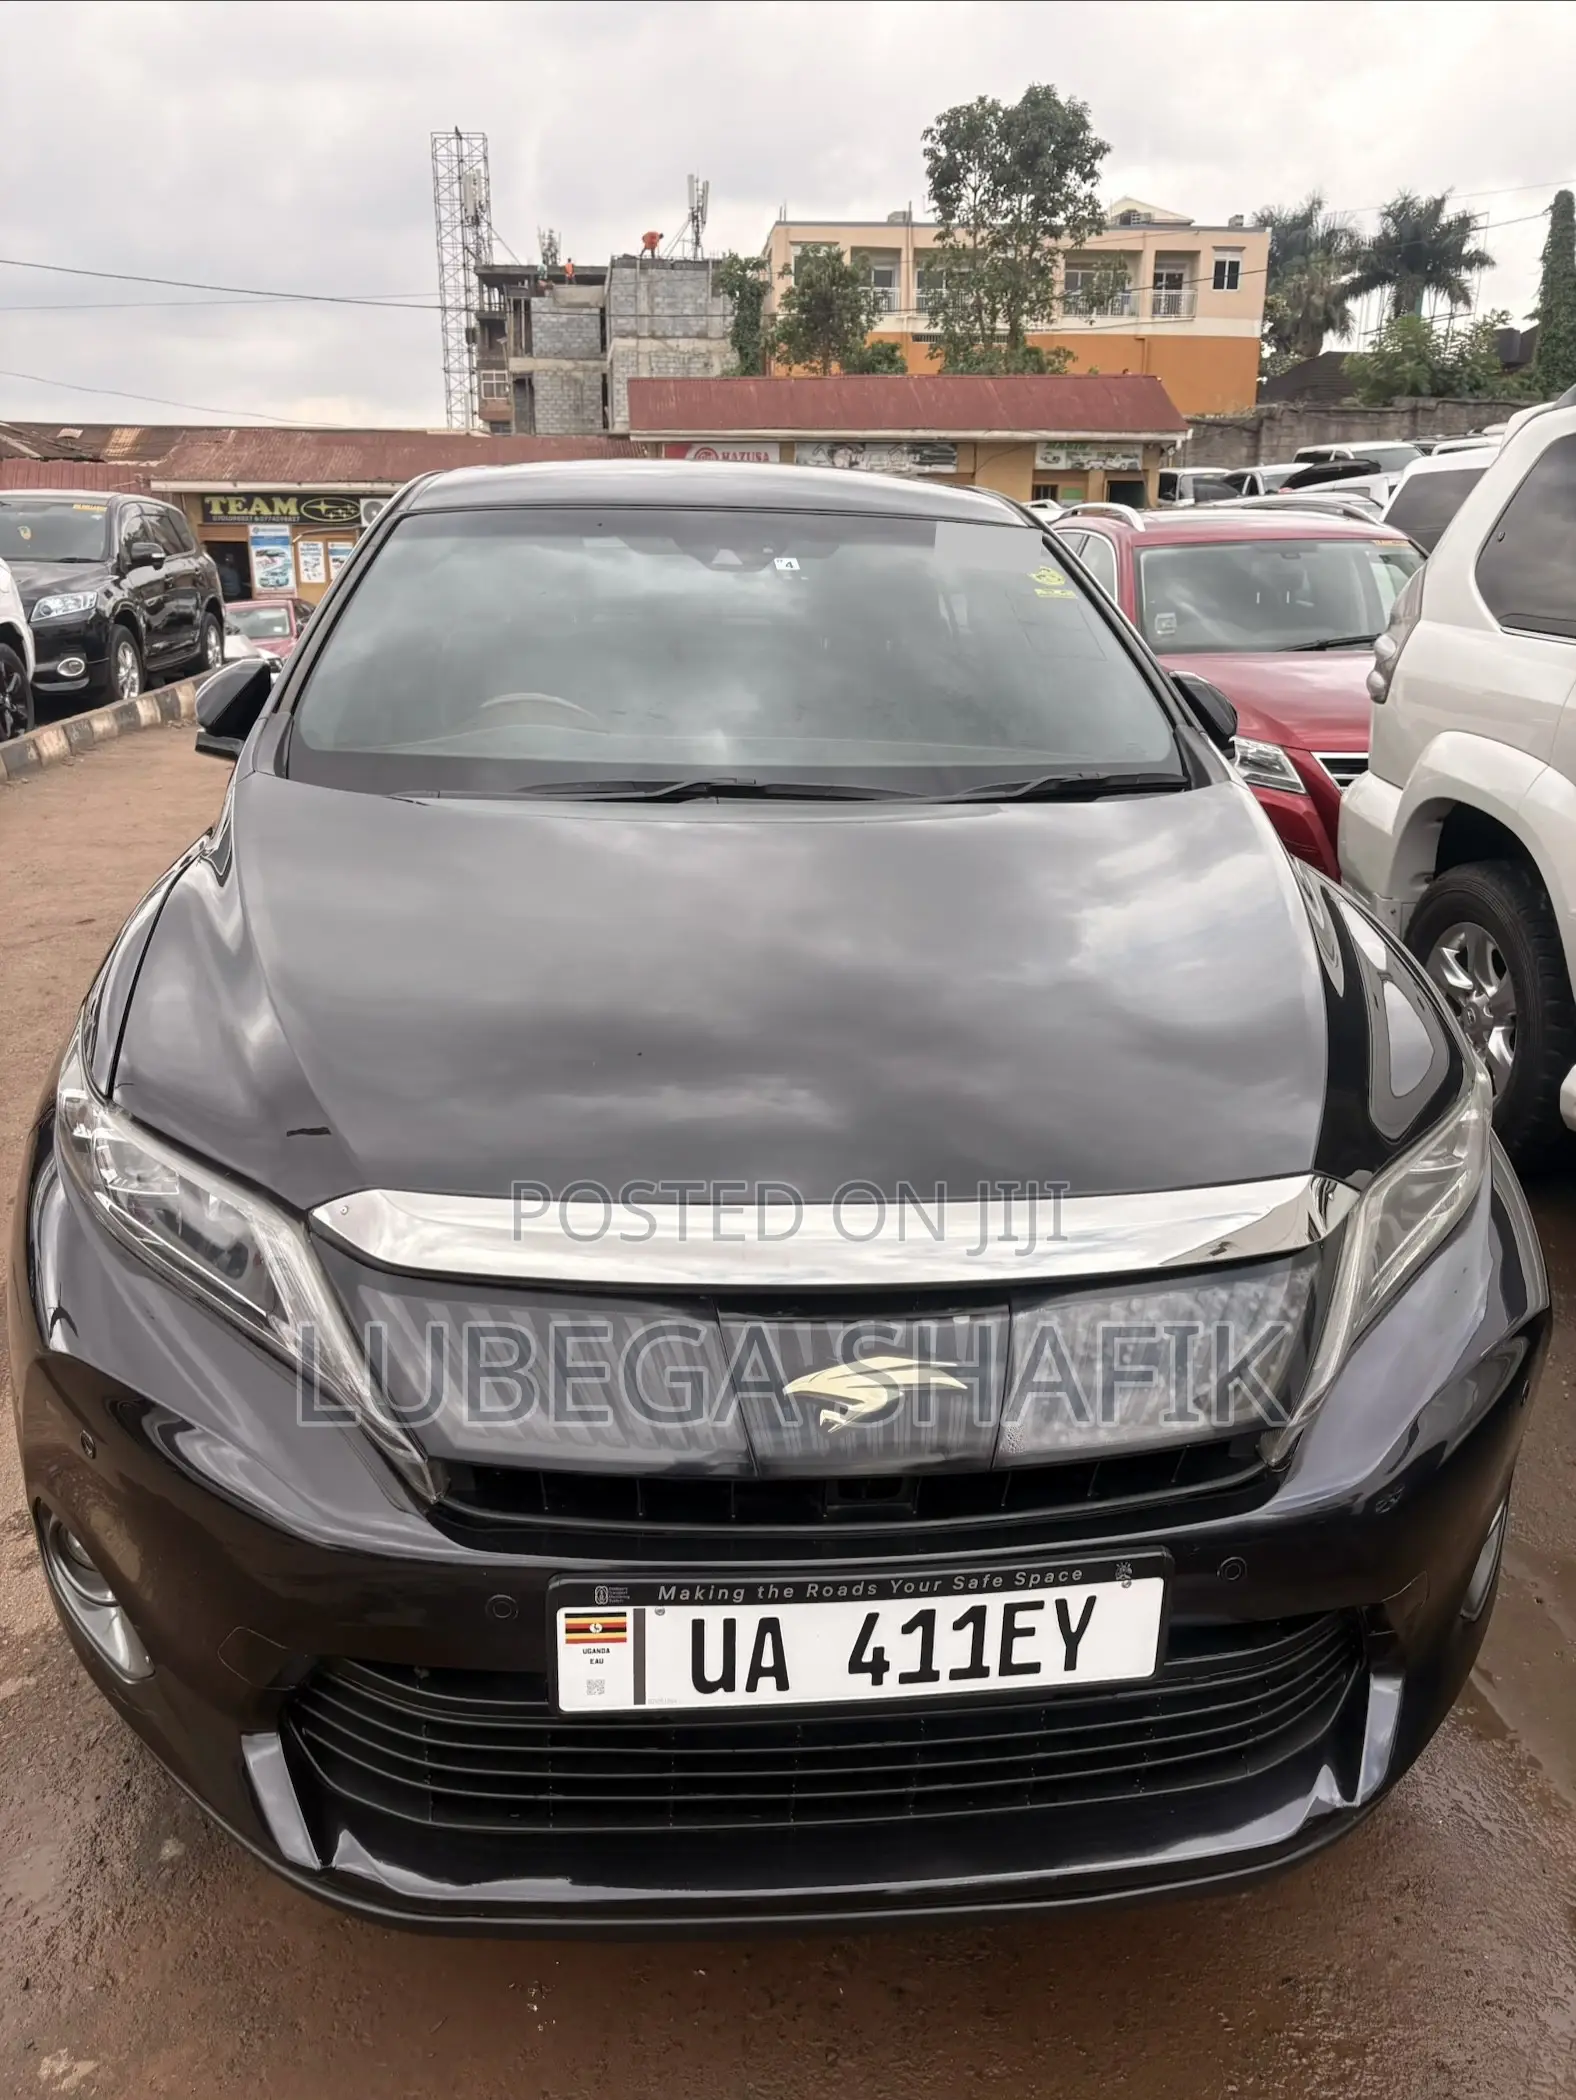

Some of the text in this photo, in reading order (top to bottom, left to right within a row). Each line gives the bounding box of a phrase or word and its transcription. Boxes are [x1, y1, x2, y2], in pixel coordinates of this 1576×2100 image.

[204, 497, 299, 516] TEAM
[658, 1568, 1083, 1602] Making the Roads Your Safe Space
[691, 1595, 1098, 1694] UA 411EY
